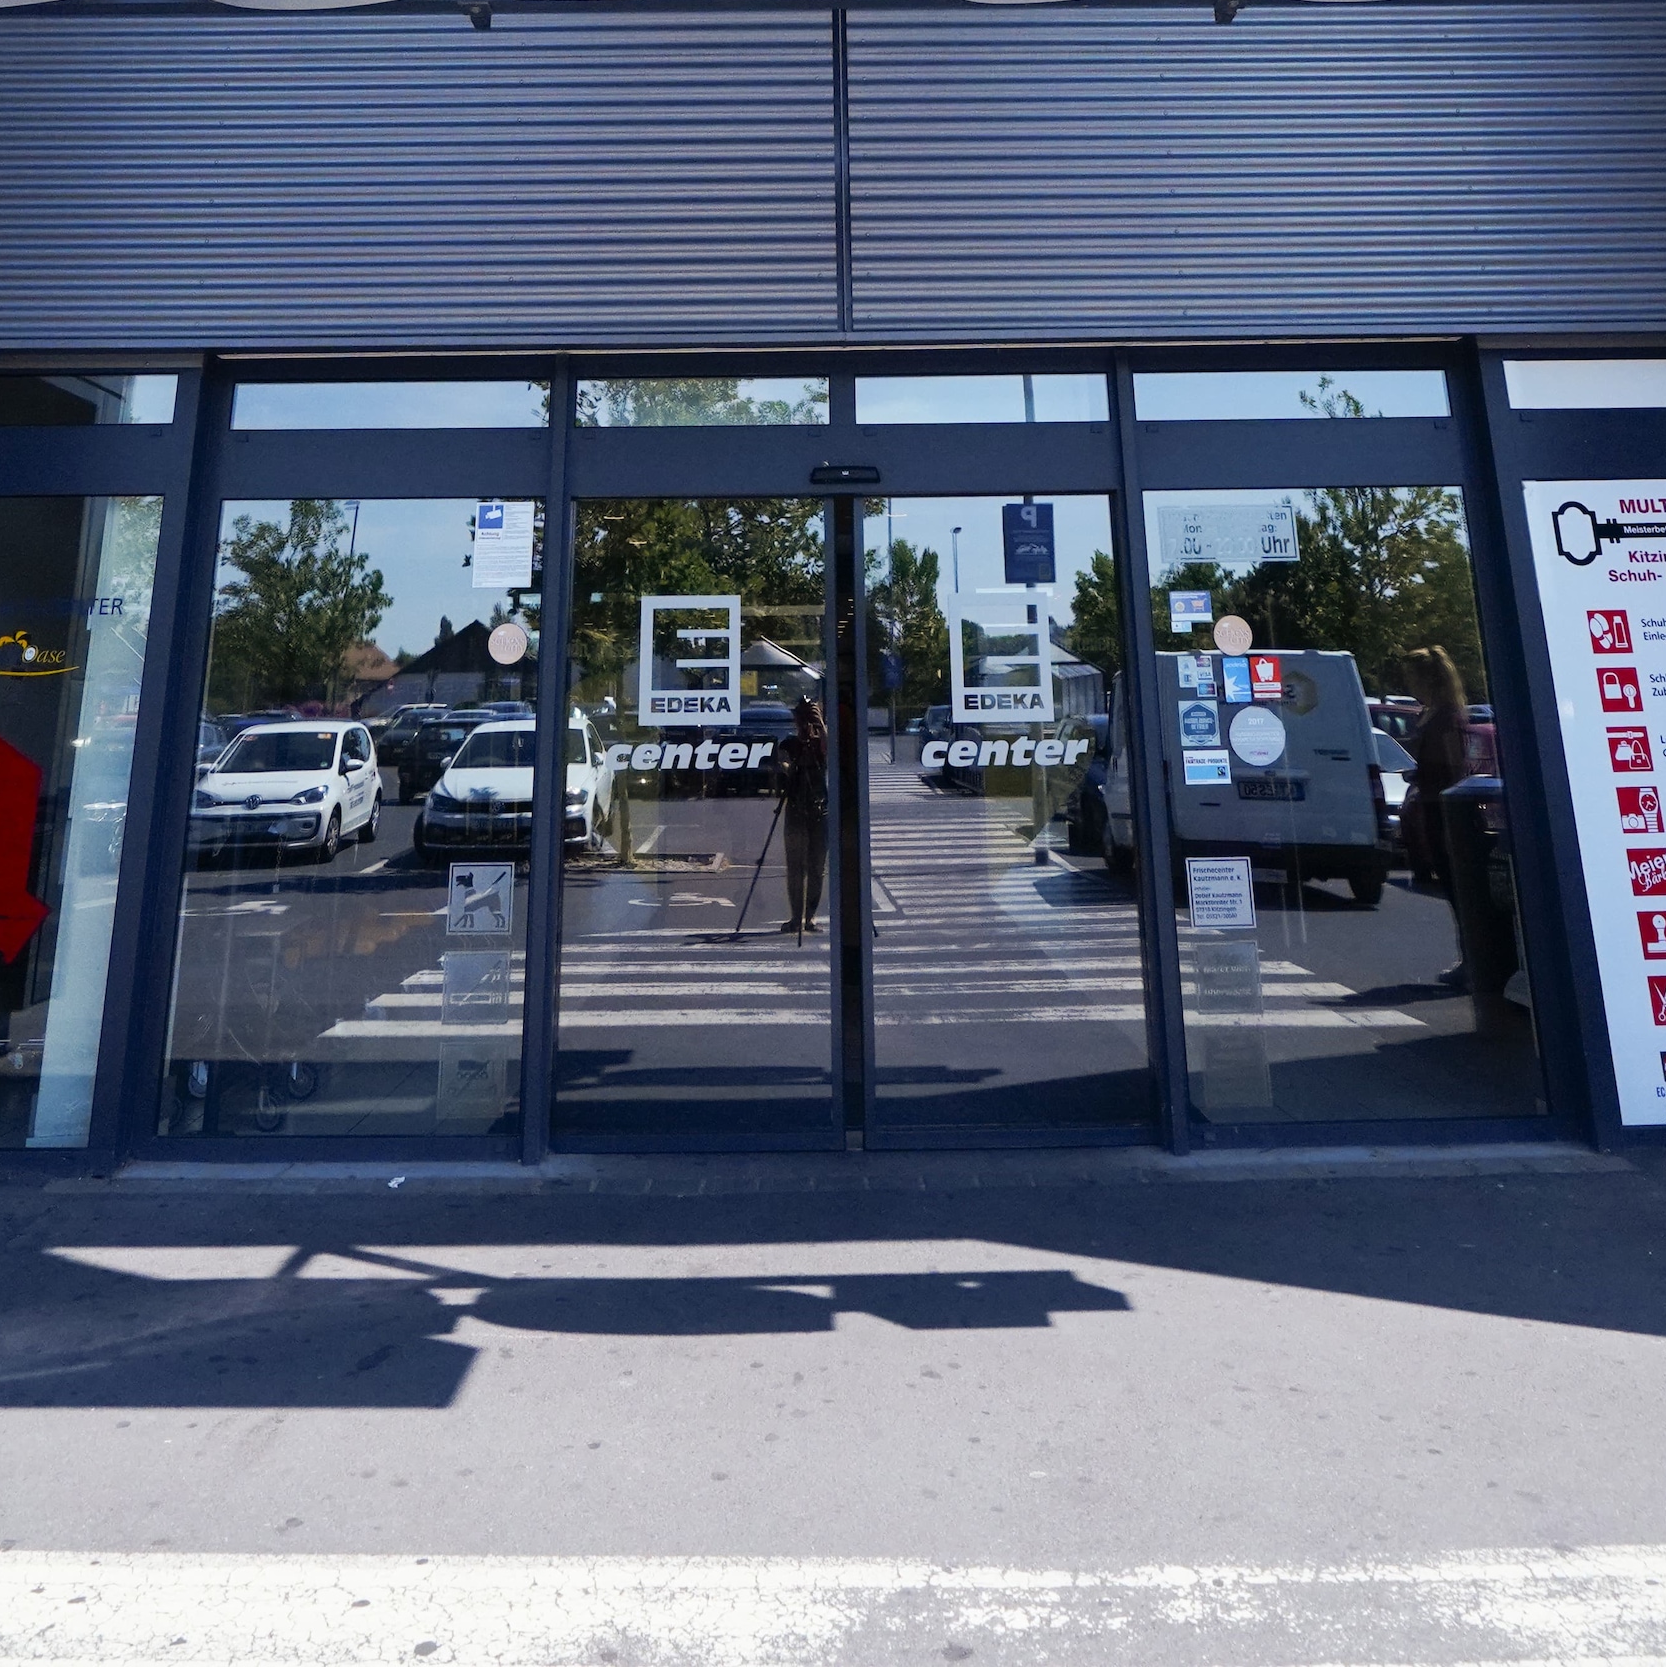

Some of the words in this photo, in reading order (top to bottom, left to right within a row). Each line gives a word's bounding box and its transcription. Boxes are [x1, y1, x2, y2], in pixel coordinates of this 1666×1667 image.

[1261, 536, 1290, 554] Uhr
[1608, 569, 1662, 582] Schuh-
[650, 696, 731, 713] EDEKA
[964, 693, 1045, 710] EDEKA
[605, 739, 774, 771] center
[921, 736, 1089, 767] center
